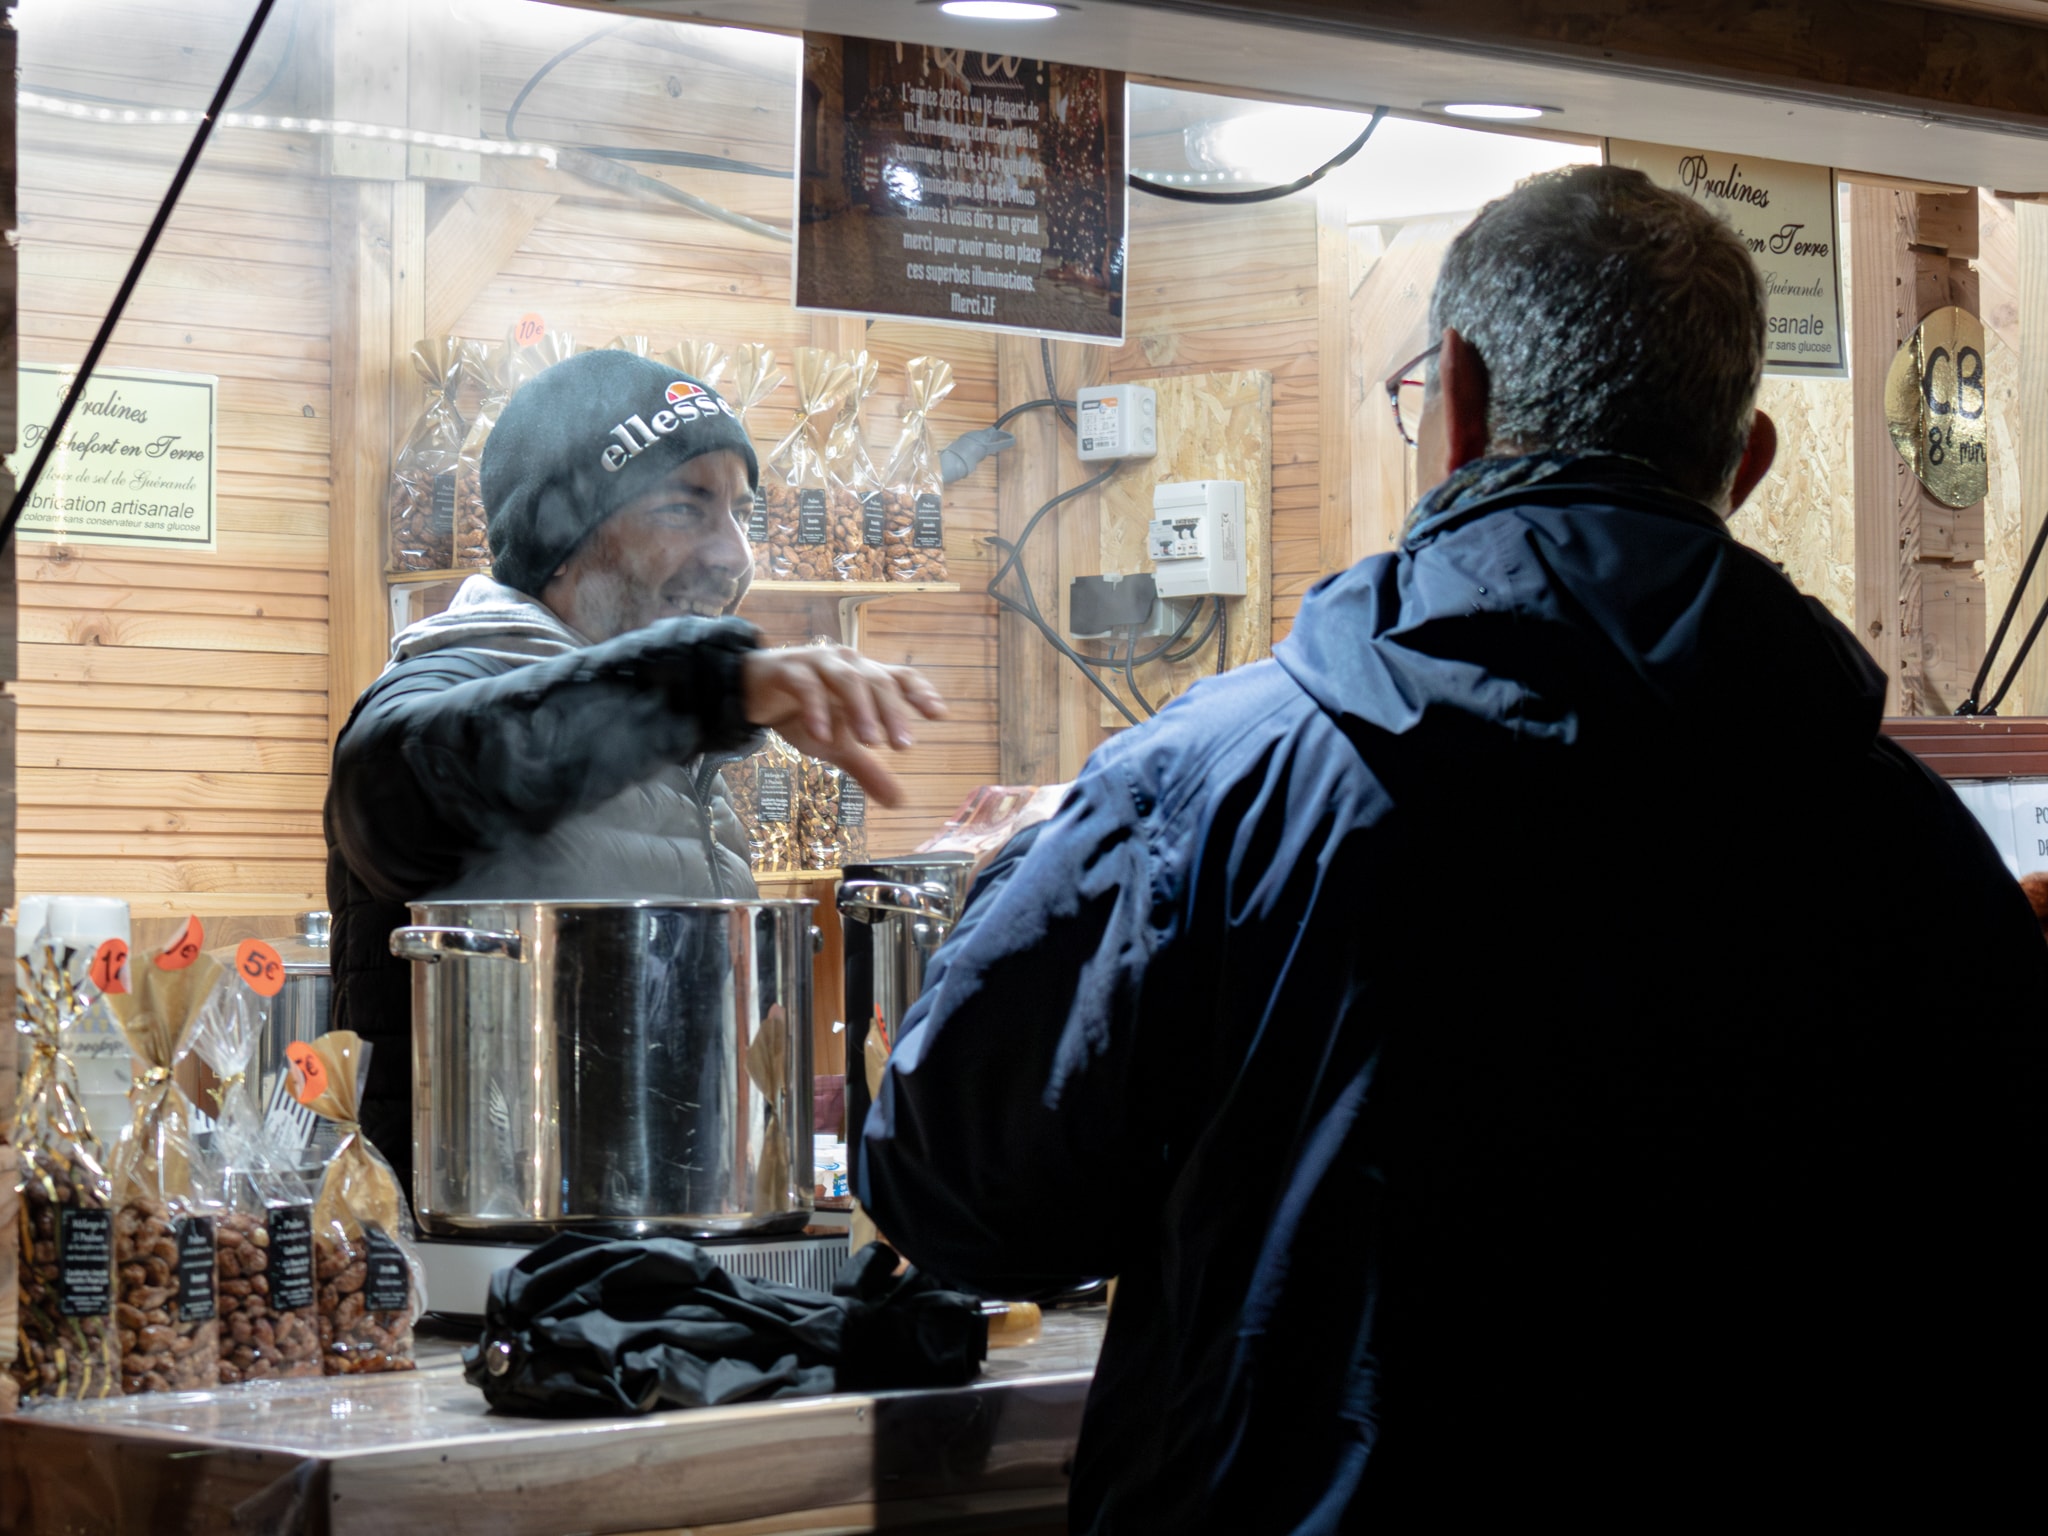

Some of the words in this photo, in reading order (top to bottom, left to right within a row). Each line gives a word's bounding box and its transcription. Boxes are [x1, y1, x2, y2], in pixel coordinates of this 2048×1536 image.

[939, 88, 961, 110] 2023
[970, 97, 982, 113] vu
[984, 94, 993, 115] le
[994, 95, 1027, 121] départ
[1028, 101, 1039, 121] de
[1016, 126, 1028, 147] de
[1029, 128, 1038, 149] la
[896, 144, 941, 165] commune
[943, 148, 957, 172] qui
[959, 150, 976, 168] fut
[1026, 157, 1042, 177] des
[973, 179, 985, 199] de
[1678, 155, 1770, 208] Pralines
[906, 205, 940, 223] tenons
[941, 204, 948, 224] à
[949, 208, 973, 227] vous
[974, 209, 993, 229] dire
[997, 215, 1010, 231] un
[1011, 214, 1039, 236] grand
[903, 230, 932, 251] merci
[934, 236, 957, 256] pour
[958, 236, 984, 256] avoir
[985, 238, 1003, 259] mis
[1004, 244, 1016, 261] en
[1017, 242, 1041, 264] place
[1768, 223, 1829, 258] Terre
[906, 262, 925, 280] ces
[925, 263, 970, 286] superbes
[971, 265, 1036, 292] illuminations.
[1762, 270, 1825, 298] Guérande
[950, 292, 980, 315] Merci
[519, 320, 544, 340] 10€
[1767, 314, 1824, 336] sanale
[1775, 341, 1797, 351] sans
[1797, 340, 1832, 354] glucose
[600, 396, 736, 472] ellesse
[120, 444, 142, 457] en
[144, 435, 205, 461] Terre
[75, 468, 90, 484] de
[92, 469, 112, 484] sel
[111, 470, 127, 486] de
[129, 468, 197, 491] Guérande
[24, 492, 106, 512] abrication
[111, 500, 195, 519] artisanale
[63, 515, 84, 525] sans
[86, 516, 142, 528] conservateur
[144, 520, 165, 530] sans
[166, 521, 201, 532] glucose
[243, 950, 280, 981] 5€
